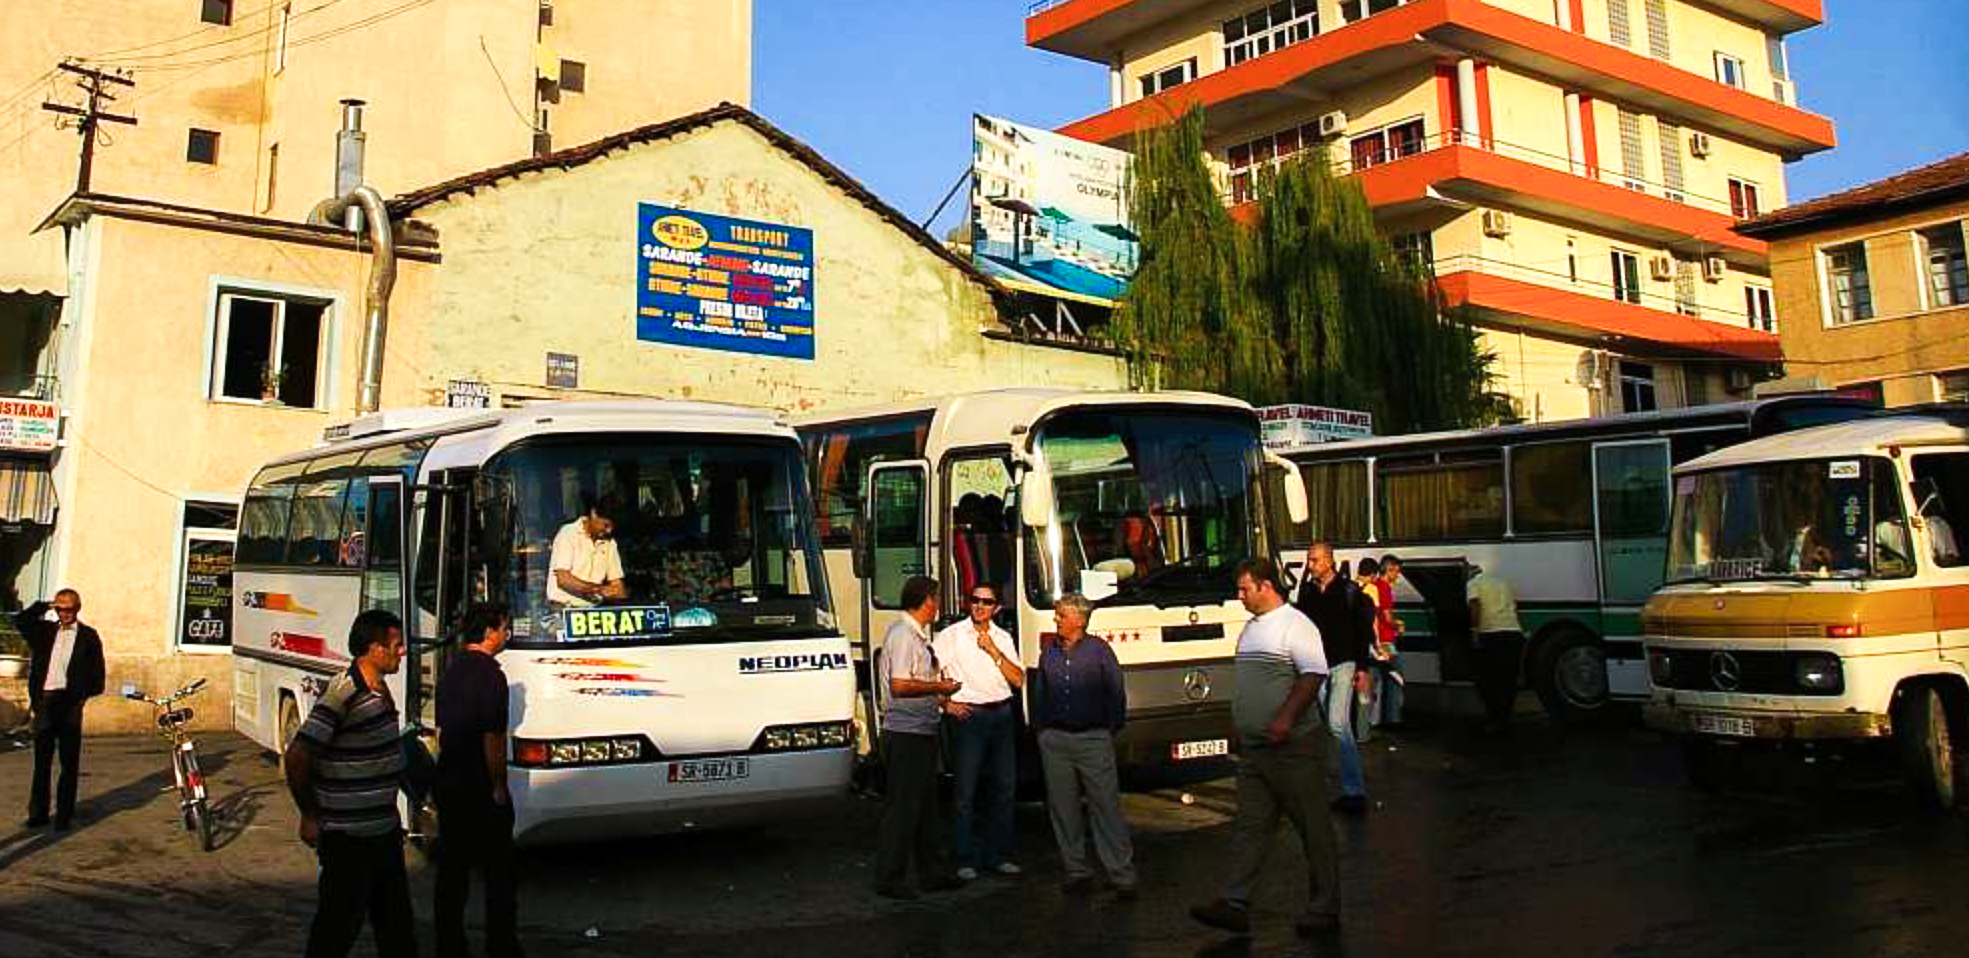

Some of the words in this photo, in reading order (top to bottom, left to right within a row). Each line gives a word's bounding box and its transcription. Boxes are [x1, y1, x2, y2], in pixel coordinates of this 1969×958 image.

[730, 225, 788, 247] TRANSPORT
[571, 609, 645, 635] BERAT
[739, 652, 848, 672] NEOPLAN
